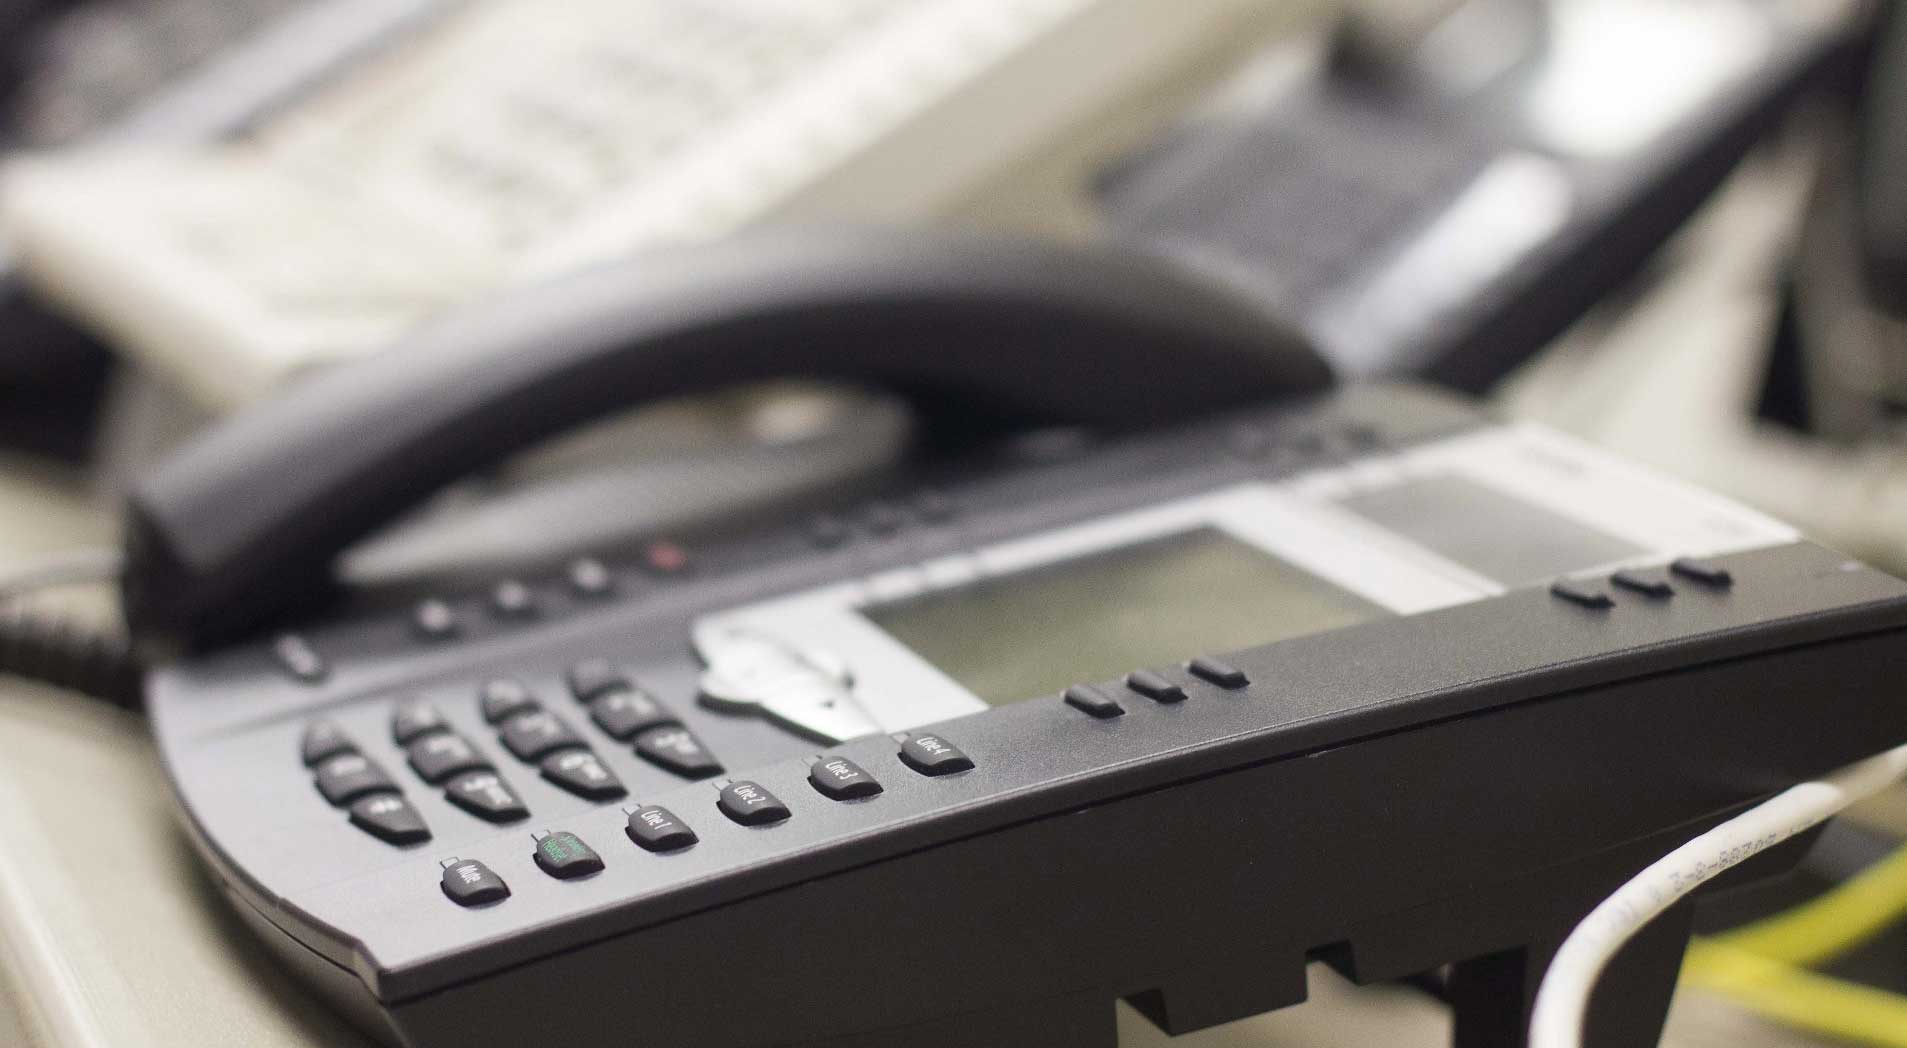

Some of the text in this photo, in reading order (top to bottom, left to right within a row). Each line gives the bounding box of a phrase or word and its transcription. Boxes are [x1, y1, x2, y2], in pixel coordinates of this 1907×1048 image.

[916, 736, 939, 751] Line
[825, 760, 848, 776] Line
[734, 785, 757, 801] Line
[640, 810, 664, 827] Line
[456, 864, 481, 885] Mute
